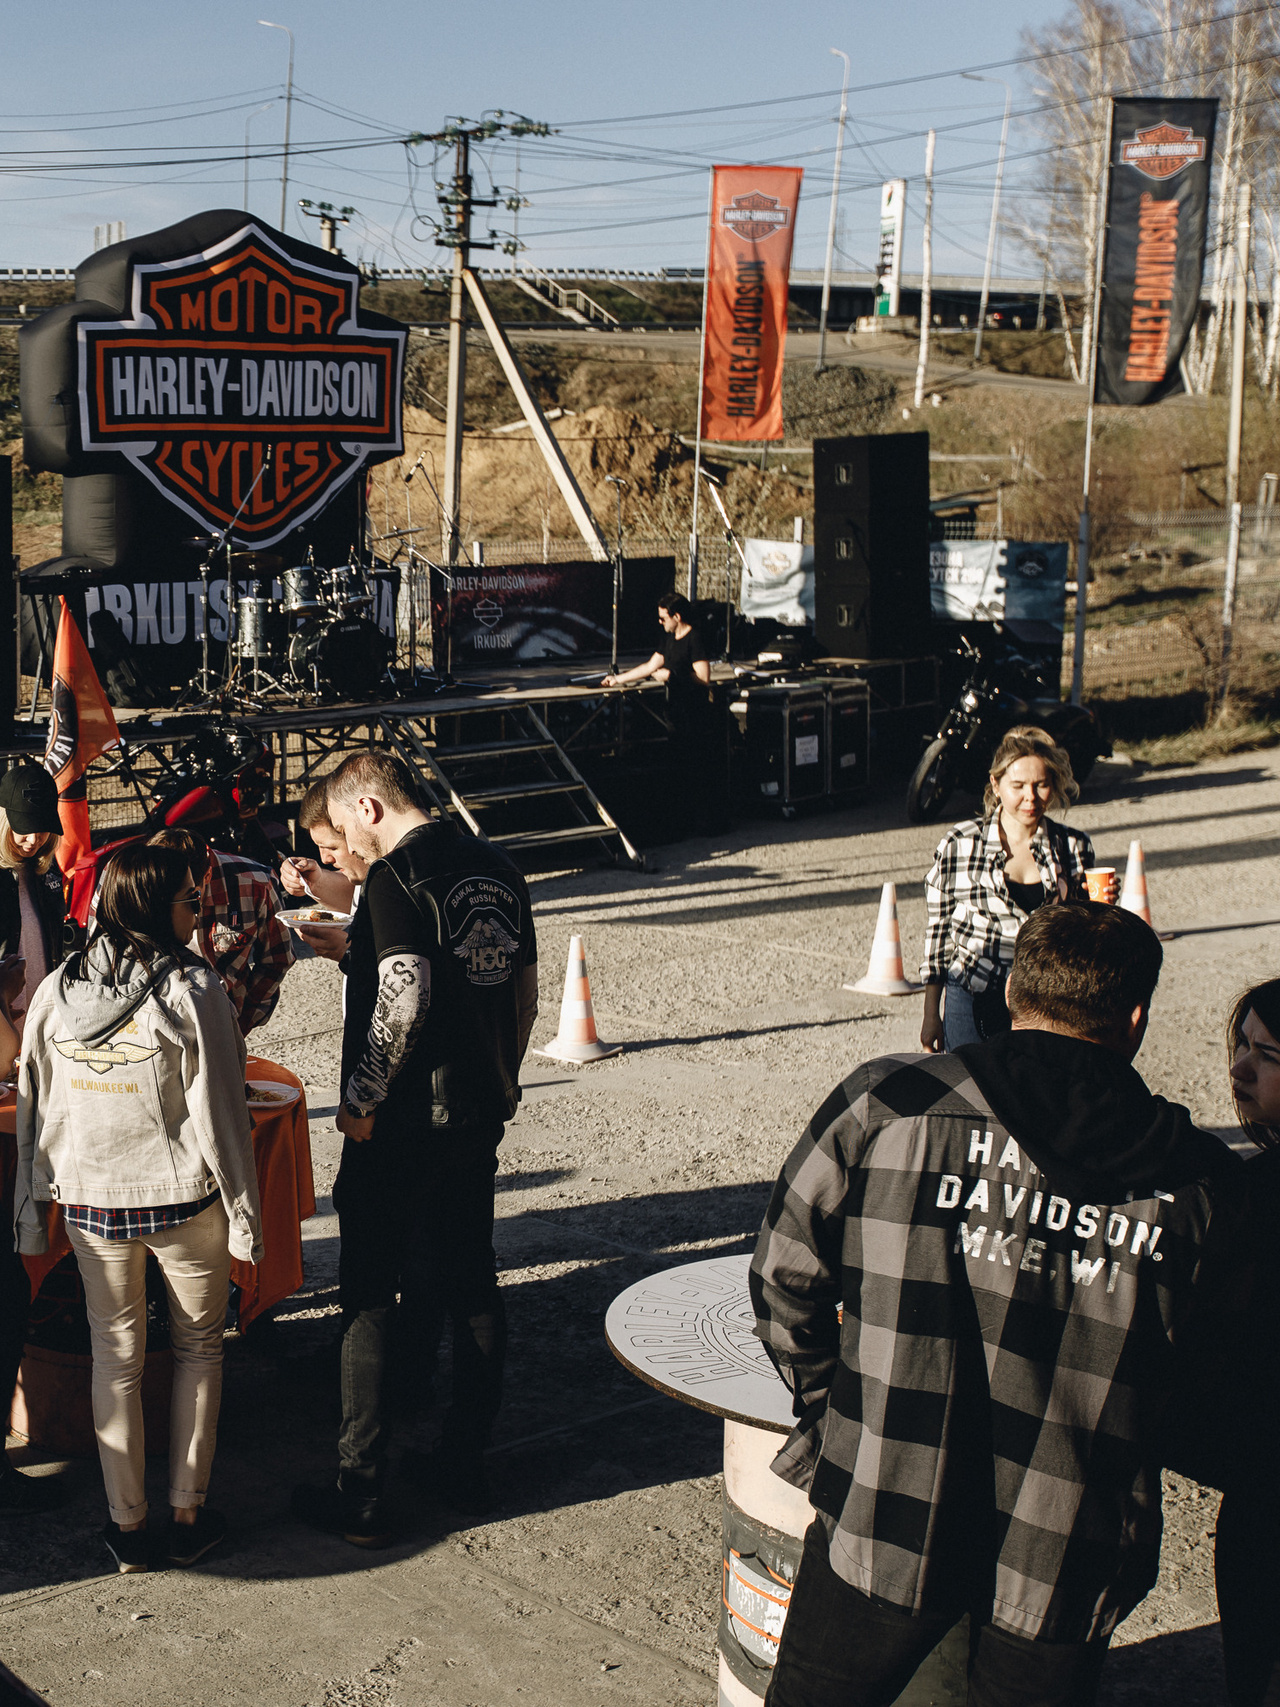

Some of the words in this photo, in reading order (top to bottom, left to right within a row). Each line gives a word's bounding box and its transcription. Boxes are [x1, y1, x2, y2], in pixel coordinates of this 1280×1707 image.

[180, 266, 322, 334] MOTOR
[726, 260, 765, 418] HARLEY-DAVIDSON
[112, 356, 378, 419] HARLEY-DAVIDSON
[181, 440, 320, 515] CYCLES
[443, 575, 526, 591] HARLEY-DAVIDSON
[473, 634, 513, 649] IRKUTSK
[451, 884, 475, 908] BAIKAL
[478, 882, 514, 904] CHAPTER
[468, 894, 498, 906] RUSSIA
[471, 945, 506, 972] HOG
[71, 1078, 124, 1094] MILWAUKEE
[1071, 1250, 1121, 1294] WI
